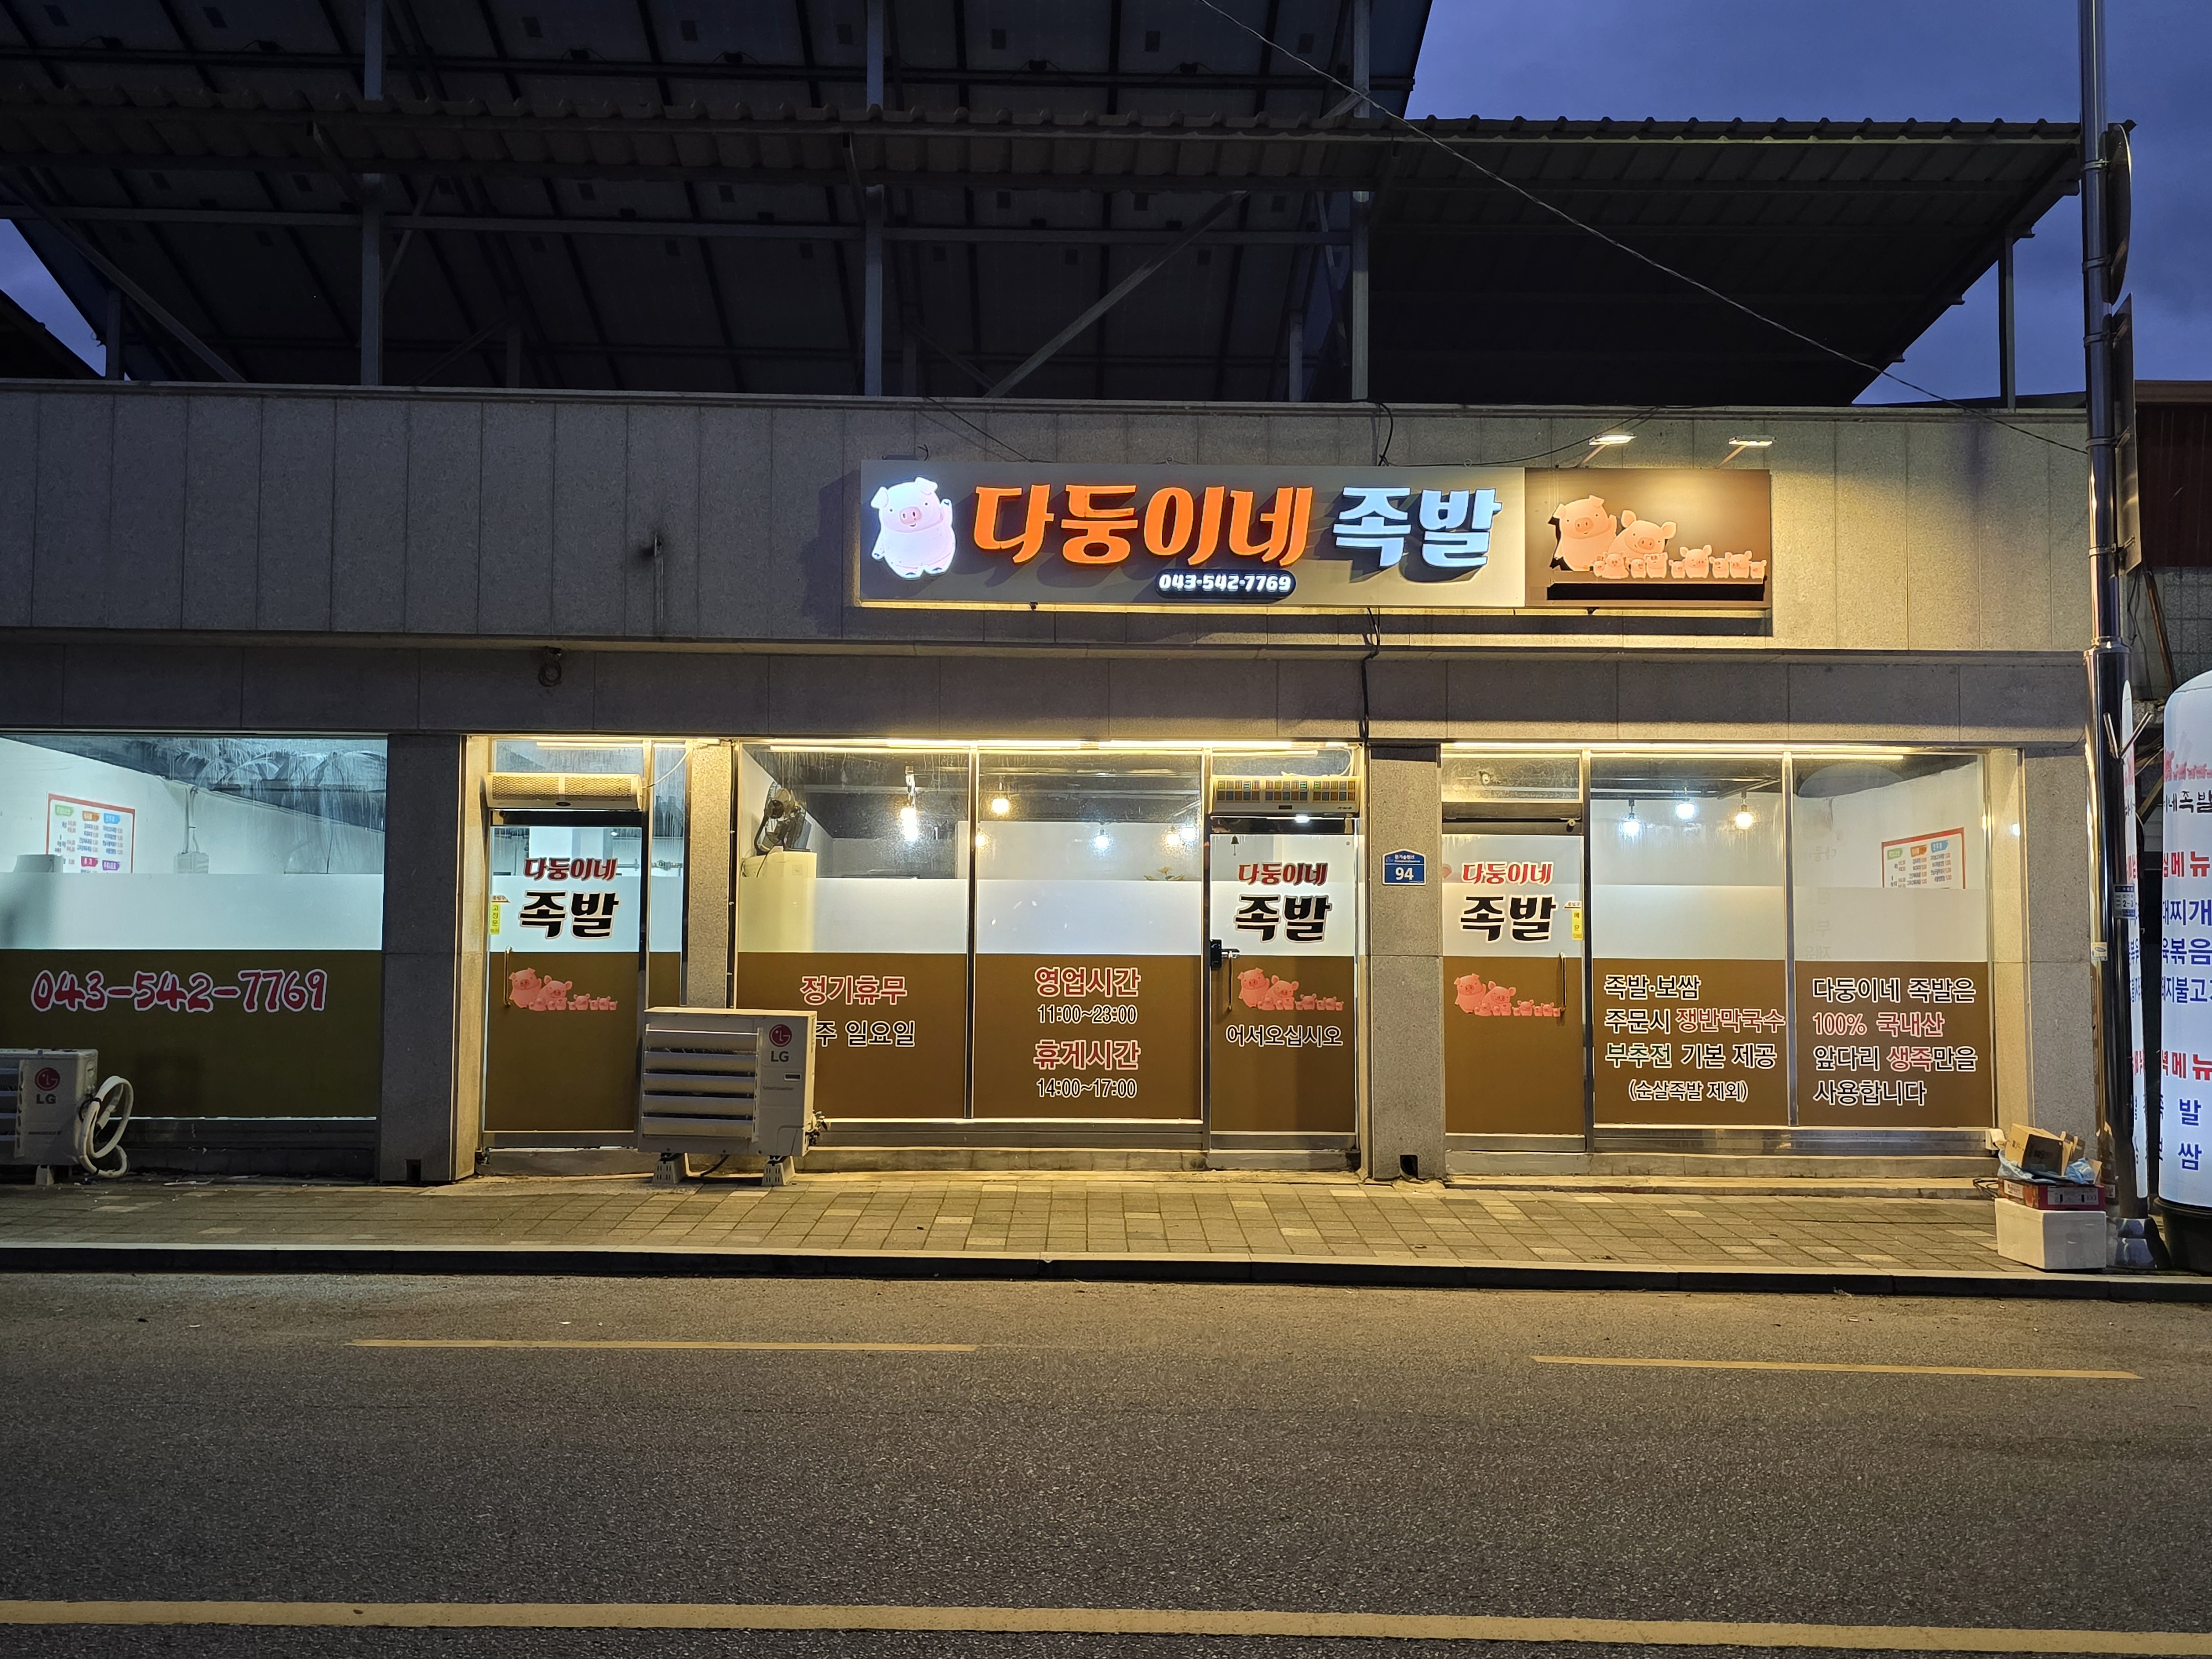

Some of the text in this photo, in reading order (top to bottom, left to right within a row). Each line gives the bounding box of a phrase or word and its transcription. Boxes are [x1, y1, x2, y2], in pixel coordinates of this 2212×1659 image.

[973, 483, 1502, 570] 다둥이네 족발
[1158, 573, 1291, 592] 043-542-7769
[523, 857, 617, 881] 다둥이네
[1238, 862, 1328, 886] 다둥이네
[1395, 867, 1414, 880] 94
[1462, 861, 1554, 885] 다둥이네
[518, 890, 619, 940] 족발
[1234, 894, 1332, 943] 족발
[1459, 895, 1557, 944] 족발
[31, 969, 327, 1011] 043-542-7769
[800, 975, 908, 1006] 정기휴무
[1034, 966, 1141, 998] 영업시간
[1812, 977, 1977, 1003] 다둥이네 족발은
[2162, 977, 2212, 1004] 지불고
[1037, 1004, 1138, 1025] 11:00~23:00
[1604, 1008, 1786, 1034] 주문시 쟁반막국수
[1812, 1011, 1945, 1037] 100% 국내산
[845, 1019, 916, 1047] 일요일
[1225, 1024, 1344, 1048] 어서오십시오
[770, 1051, 789, 1062] LG
[1033, 1040, 1141, 1071] 휴게시간
[1605, 1042, 1778, 1068] 부추전 기본 제공
[1813, 1045, 1979, 1072] 앞다리 생족만을
[36, 1093, 56, 1104] LG
[1036, 1078, 1138, 1098] 14:00~17:00
[1628, 1079, 1749, 1102] (순살족발 제외)
[1813, 1080, 1927, 1105] 사용합니다
